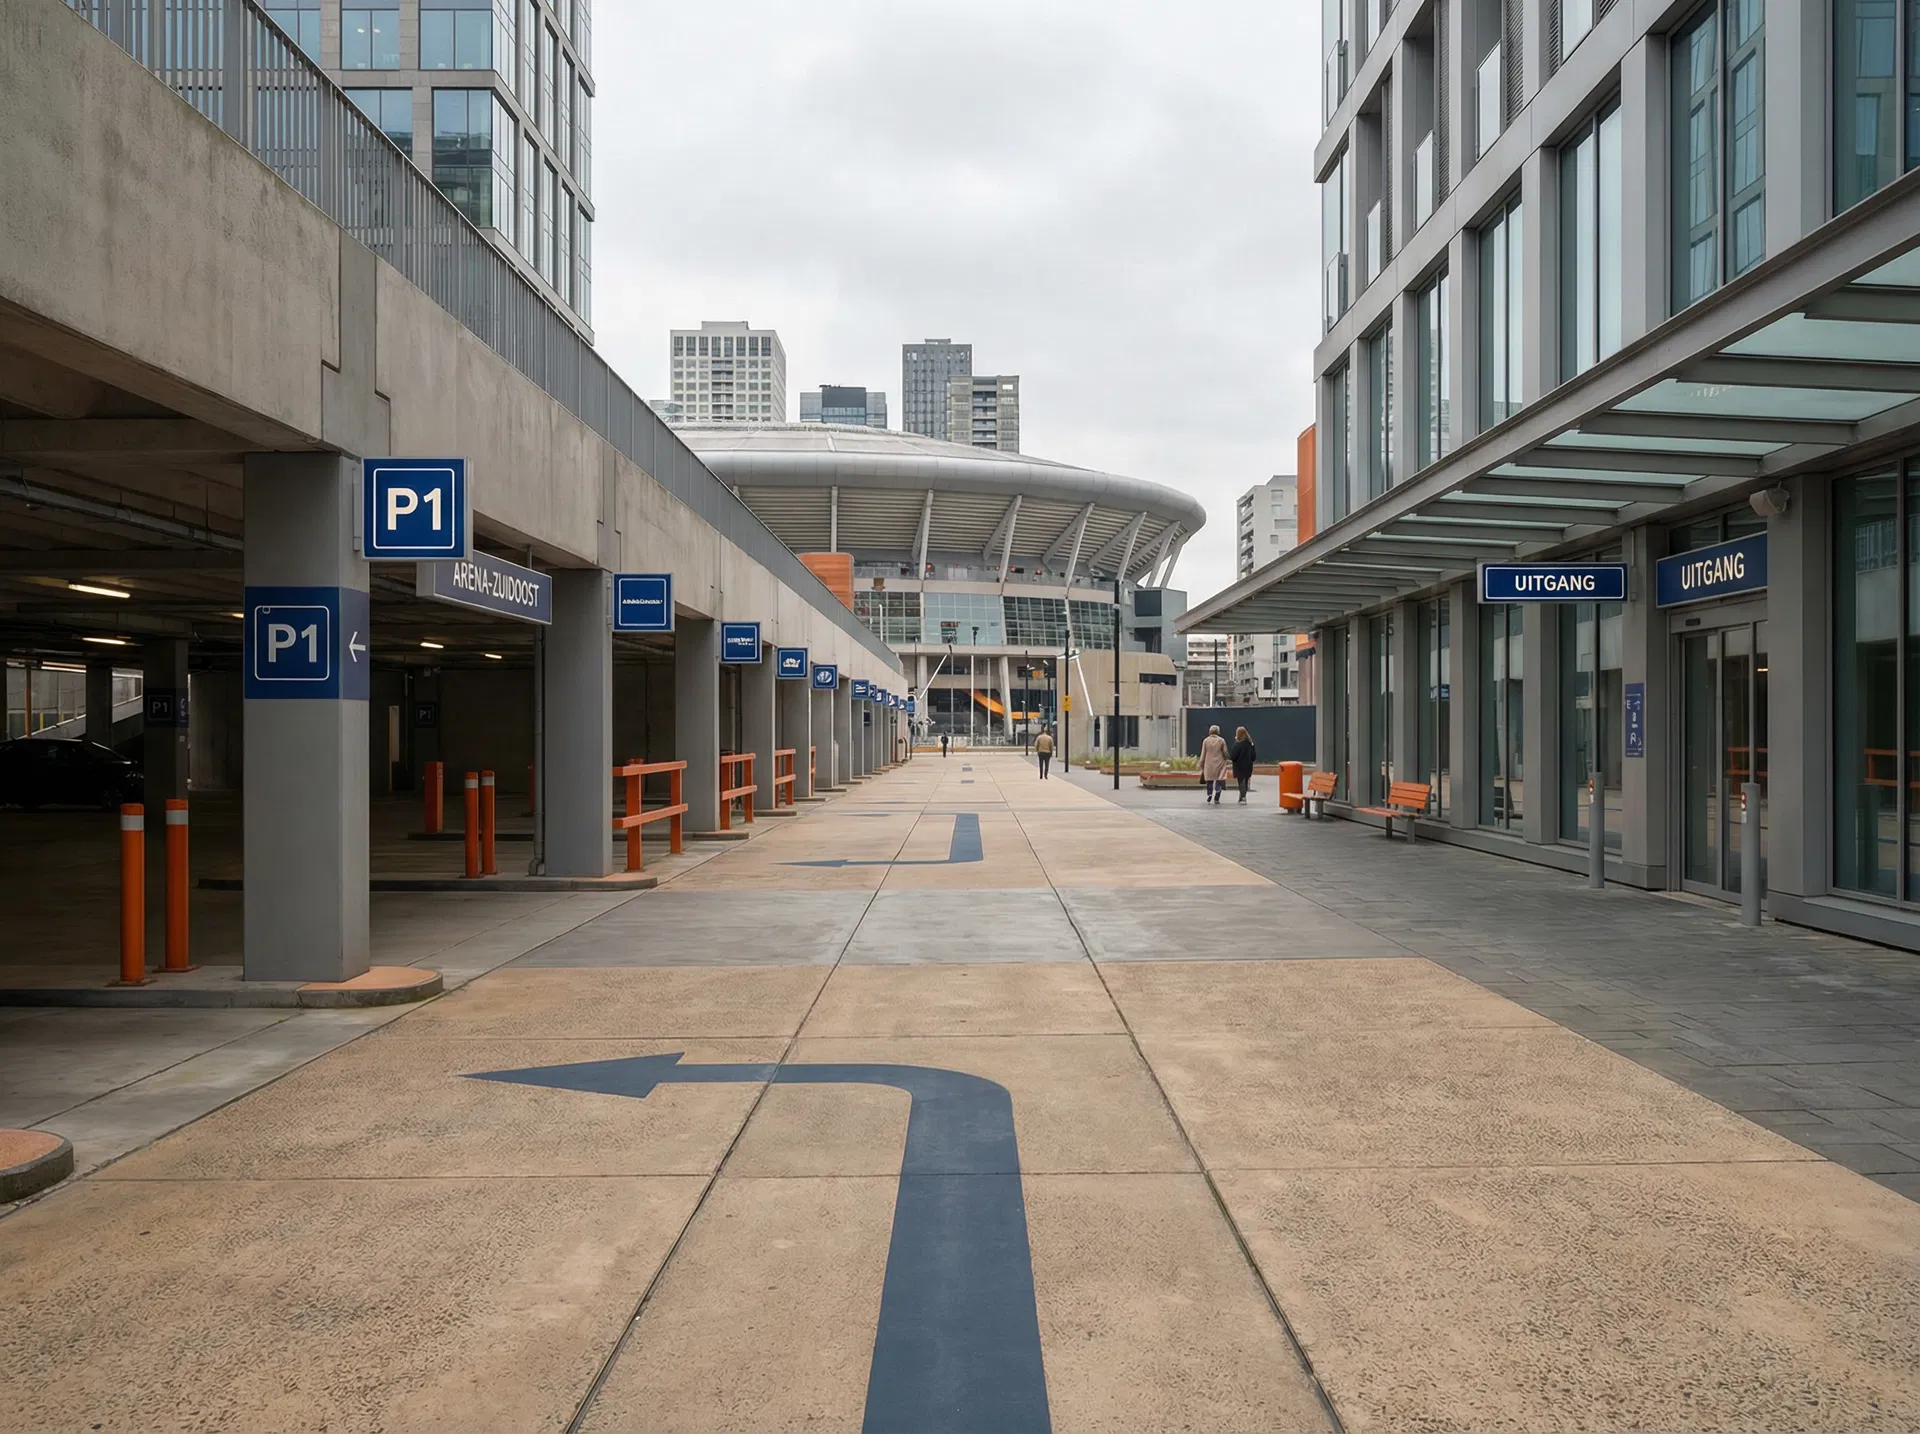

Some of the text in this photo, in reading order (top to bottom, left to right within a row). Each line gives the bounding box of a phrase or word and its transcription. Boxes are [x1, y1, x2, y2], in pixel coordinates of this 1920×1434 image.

[387, 488, 441, 530] P1
[453, 562, 540, 607] ARENA-ZUIDOOST
[1515, 575, 1595, 591] UITGANG
[1681, 552, 1745, 590] UITGANG
[268, 624, 317, 663] P1
[152, 701, 168, 713] P1
